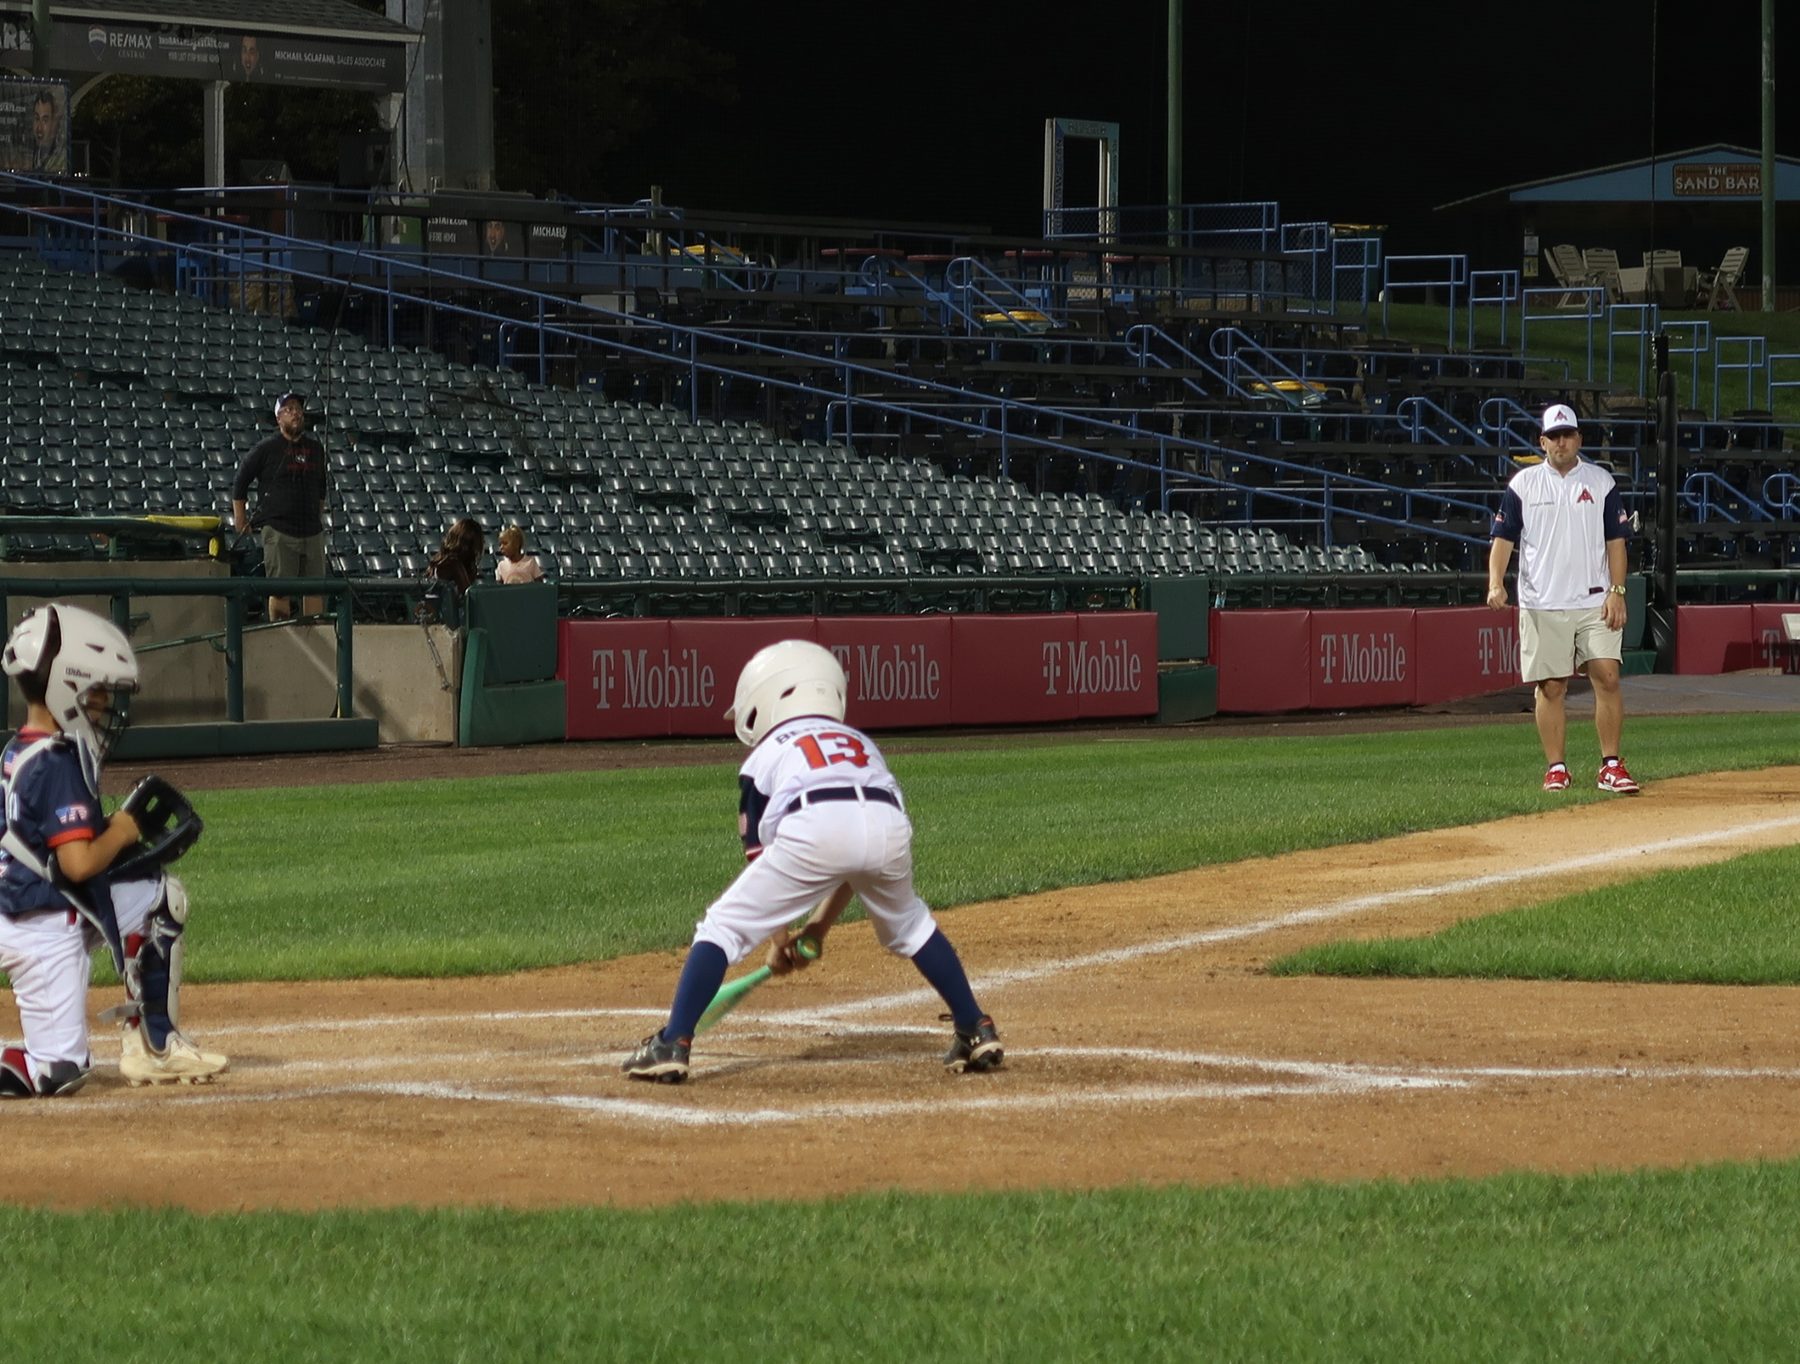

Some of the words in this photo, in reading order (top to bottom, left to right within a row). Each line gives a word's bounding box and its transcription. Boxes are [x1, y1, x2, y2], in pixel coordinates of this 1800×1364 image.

[109, 32, 152, 50] RE/MAX
[274, 49, 302, 62] MICHAEL
[353, 56, 387, 68] ASSOCIATE
[1675, 176, 1720, 190] SAND
[1725, 176, 1760, 190] BAR
[1707, 166, 1728, 176] THE
[857, 644, 941, 701] Mobile
[1066, 639, 1142, 694] Mobile
[1341, 632, 1407, 684] Mobile
[622, 648, 716, 709] Mobile
[793, 731, 870, 771] 13
